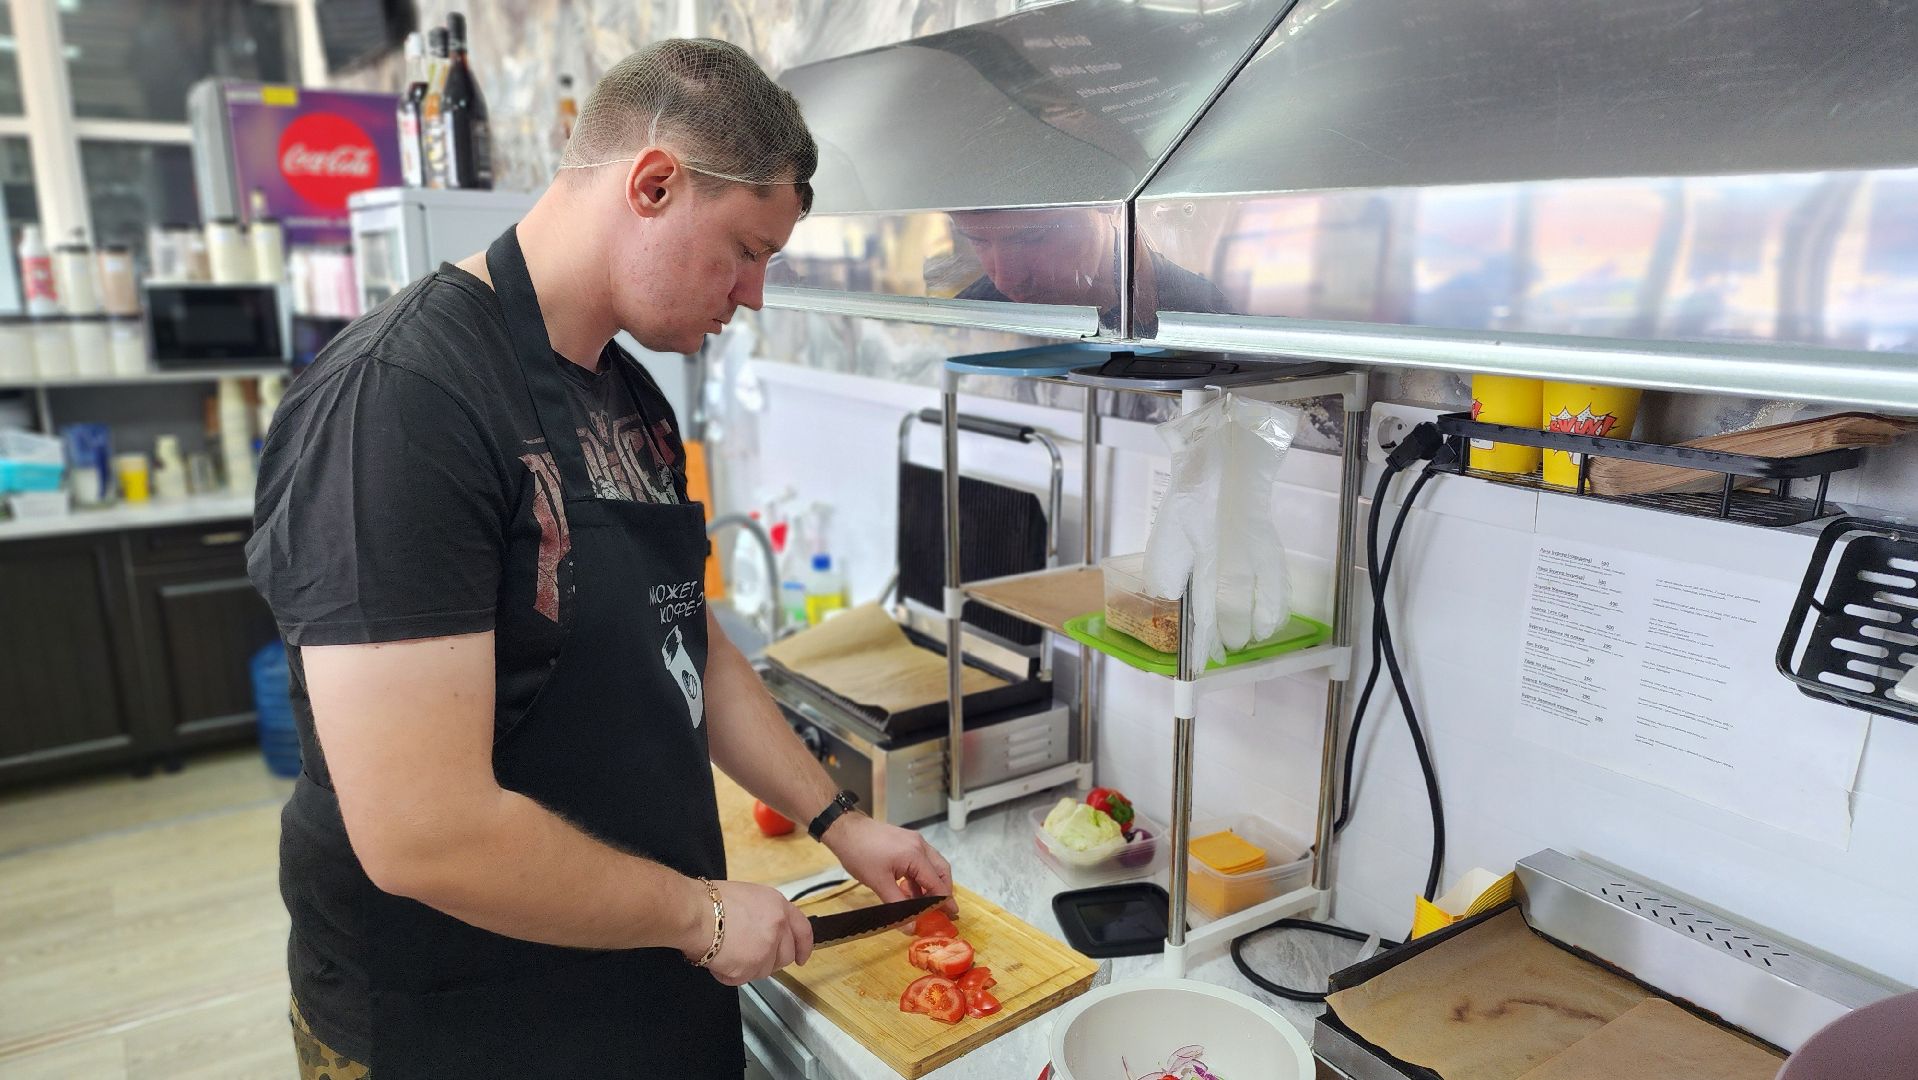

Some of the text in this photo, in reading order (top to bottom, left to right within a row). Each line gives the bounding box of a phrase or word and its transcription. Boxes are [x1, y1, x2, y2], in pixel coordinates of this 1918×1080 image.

[283, 142, 372, 176] Coca-Cola
[649, 580, 698, 607] МОЖЕТ
[659, 591, 704, 625] КОФЕ?
